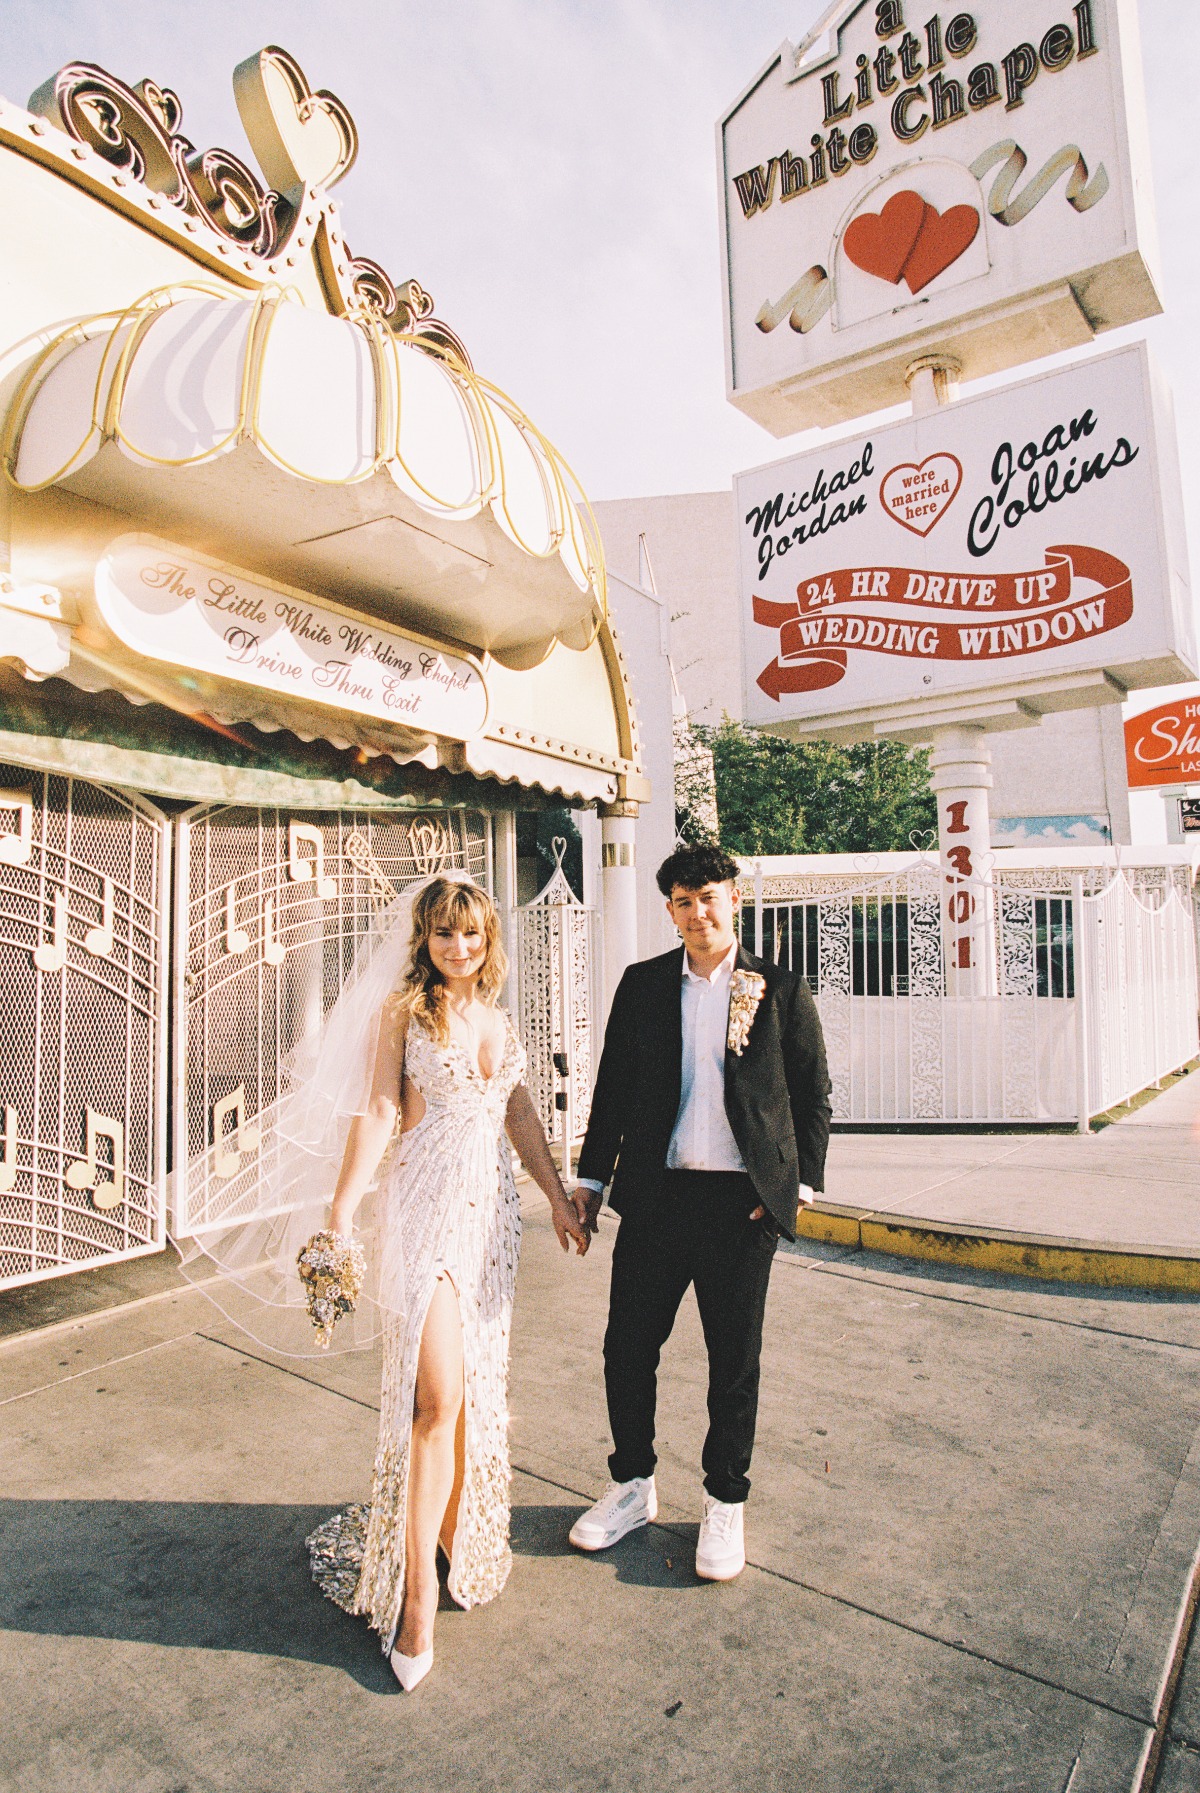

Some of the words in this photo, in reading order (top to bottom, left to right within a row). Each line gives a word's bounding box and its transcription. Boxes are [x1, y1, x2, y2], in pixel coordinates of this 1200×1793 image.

[875, 0, 905, 40] a
[732, 122, 877, 219] White
[891, 0, 1098, 142] Chapel
[820, 12, 978, 126] Little
[745, 442, 874, 538] Michael
[891, 479, 950, 508] married
[901, 468, 936, 489] were
[966, 437, 1139, 557] Collins
[990, 408, 1098, 505] Joan
[758, 494, 867, 581] Jordan
[905, 501, 938, 521] here
[139, 561, 196, 600] The
[203, 577, 268, 624] Little
[274, 601, 333, 646] White
[338, 624, 413, 681] Wedding
[418, 652, 472, 692] Chapel
[798, 615, 940, 655] WEDDING
[958, 599, 1107, 656] WINDOW
[806, 578, 836, 607] 24
[850, 571, 892, 598] HR
[905, 573, 997, 607] DRIVE
[1014, 572, 1058, 605] UP
[223, 626, 303, 681] Drive
[311, 660, 374, 701] Thru
[381, 674, 423, 714] Exit
